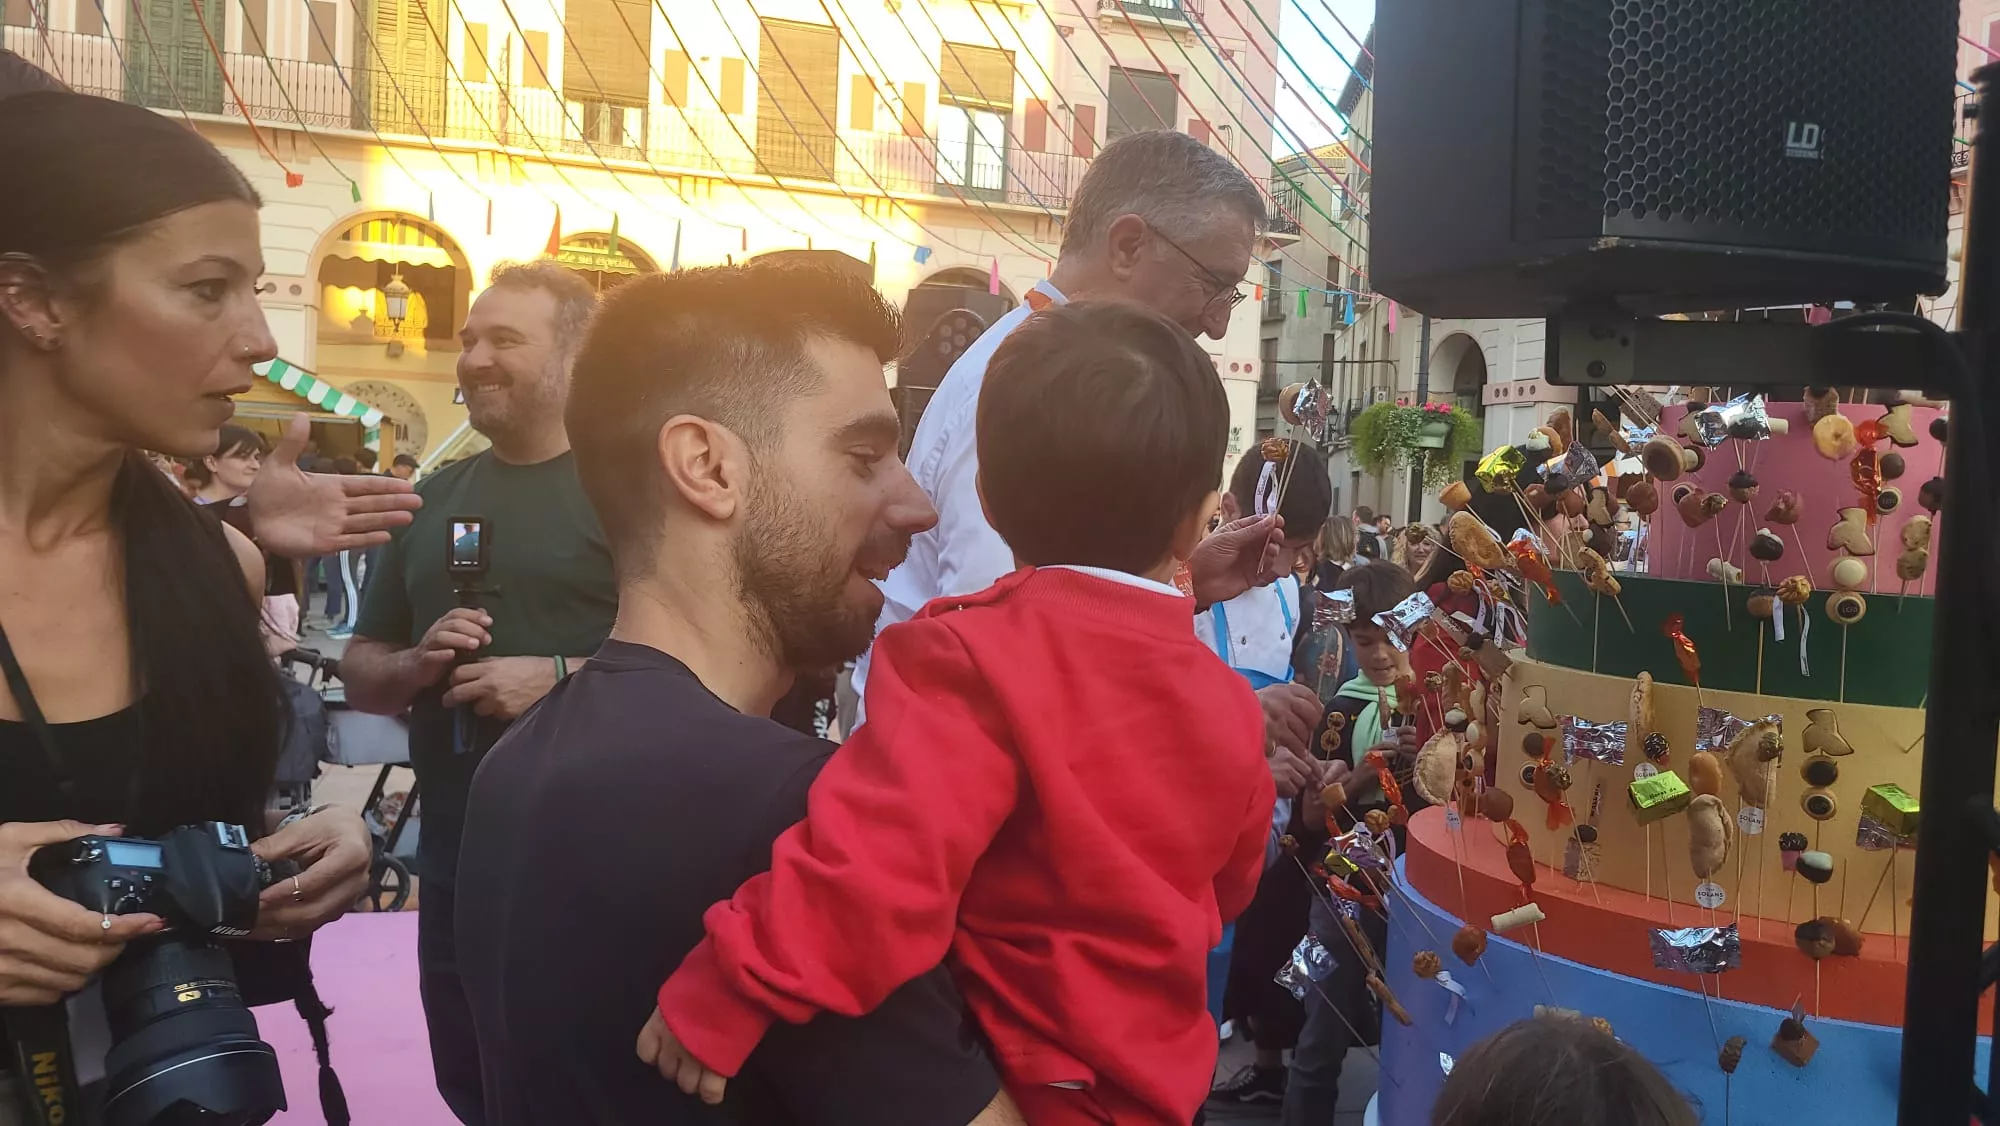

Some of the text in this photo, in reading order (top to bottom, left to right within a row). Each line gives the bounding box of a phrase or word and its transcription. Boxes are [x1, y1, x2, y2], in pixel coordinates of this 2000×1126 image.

[1787, 121, 1819, 149] LD
[1739, 814, 1761, 824] SOLAN
[1697, 890, 1723, 898] SOLANS
[210, 925, 250, 936] Nikon
[31, 1051, 65, 1126] Niko
